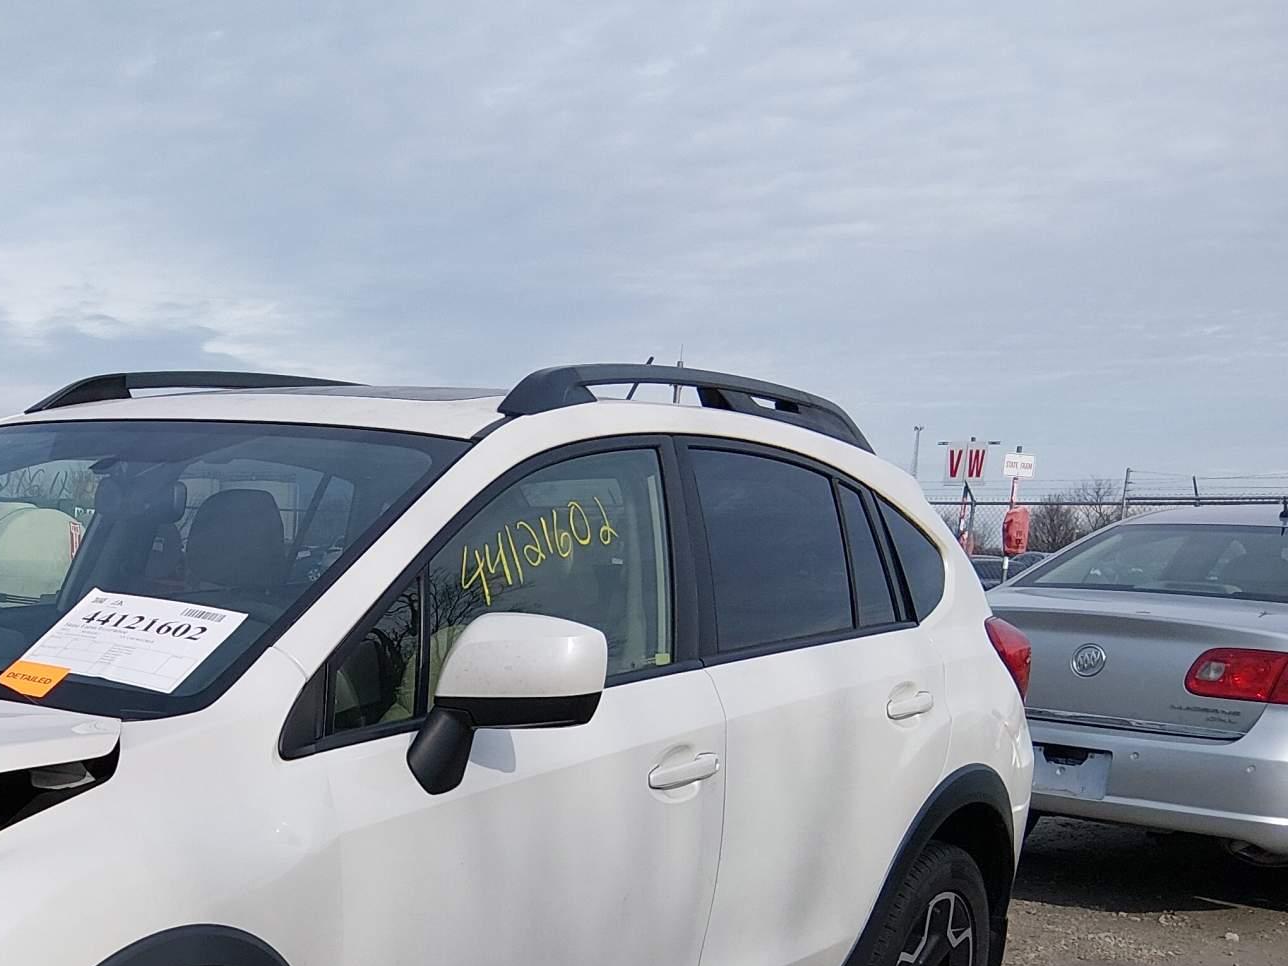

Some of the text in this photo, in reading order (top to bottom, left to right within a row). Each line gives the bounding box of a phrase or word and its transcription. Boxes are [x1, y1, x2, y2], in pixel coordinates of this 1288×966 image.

[462, 496, 619, 606] 44121602
[82, 610, 208, 641] 44121602
[6, 671, 53, 685] DETAILED
